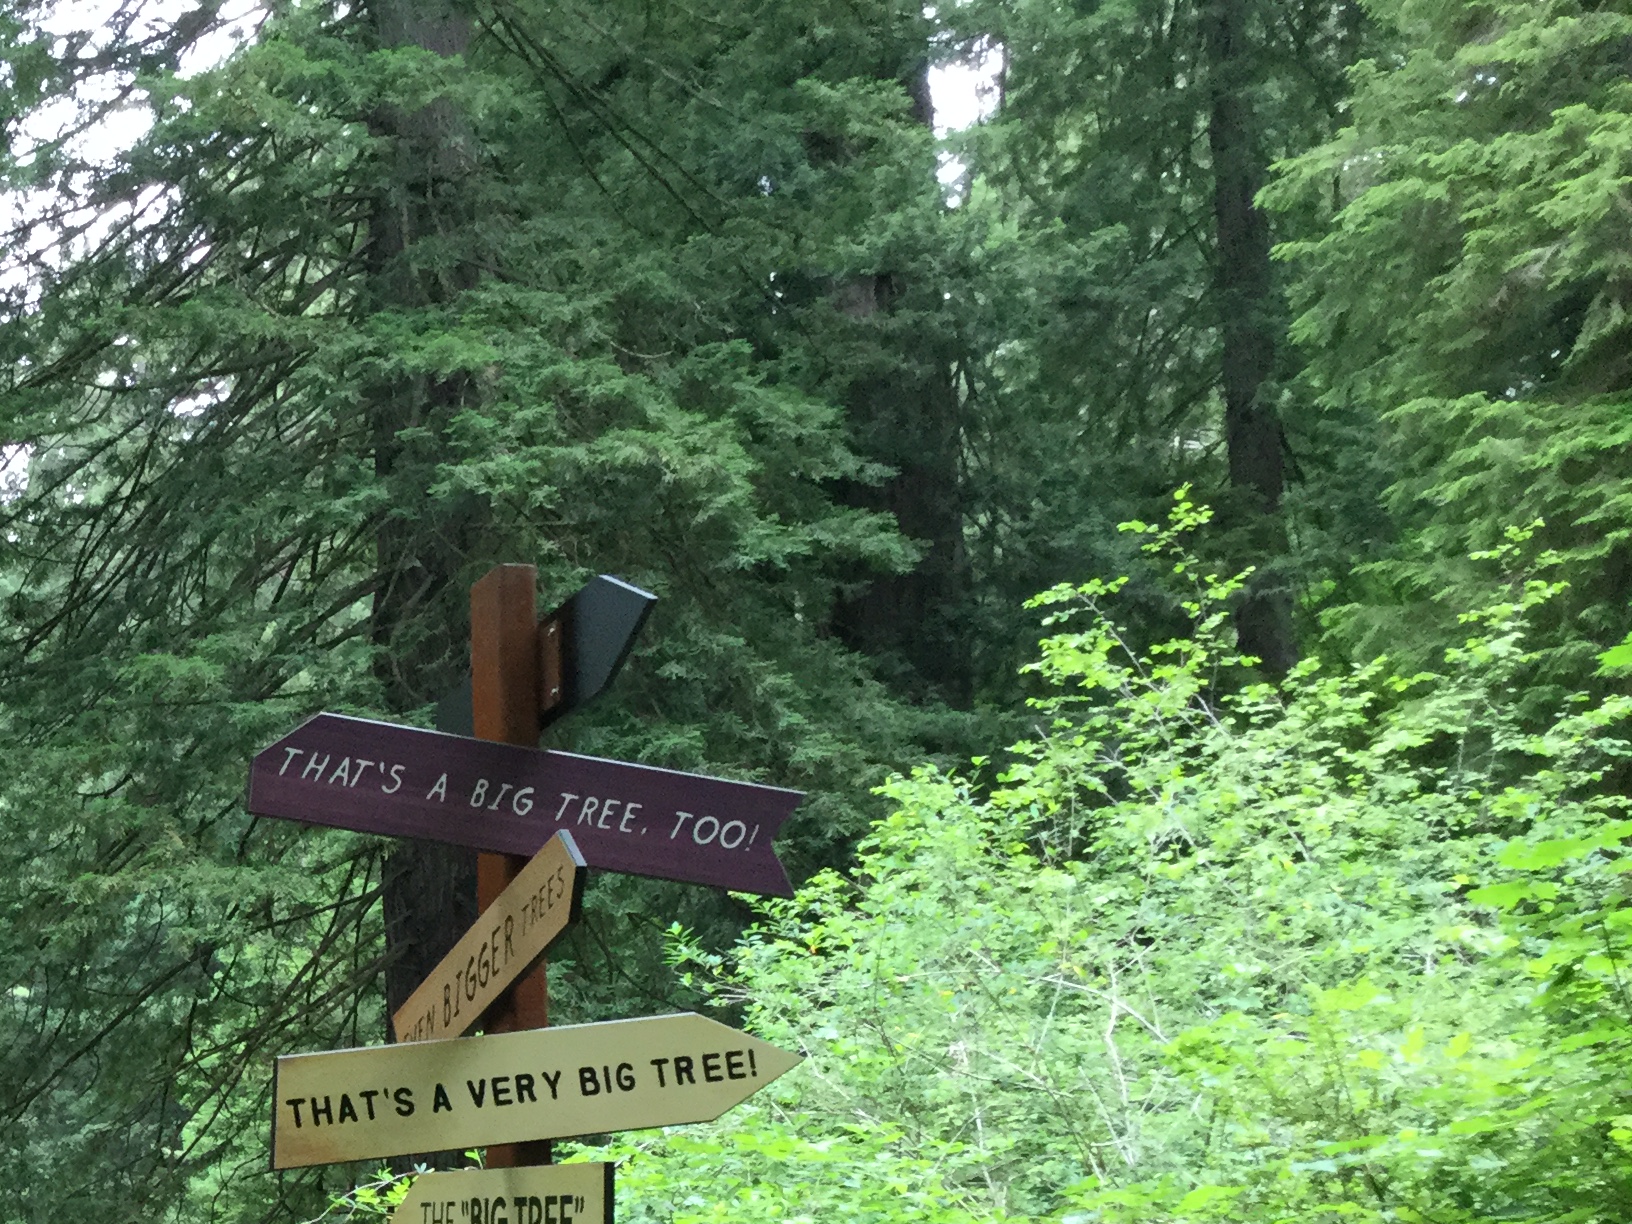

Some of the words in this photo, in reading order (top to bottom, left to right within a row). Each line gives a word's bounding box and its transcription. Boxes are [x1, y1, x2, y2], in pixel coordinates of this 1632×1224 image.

[277, 746, 406, 795] THAT'S
[426, 772, 449, 803] A
[470, 778, 534, 817] BIG
[669, 810, 760, 853] TOO!
[443, 914, 515, 1029] BIGGER
[521, 864, 565, 937] TREES
[285, 1086, 415, 1129] THAT'S
[432, 1083, 453, 1113] A
[466, 1069, 563, 1109] VERY
[578, 1061, 636, 1095] BIG
[649, 1048, 759, 1088] TREE!
